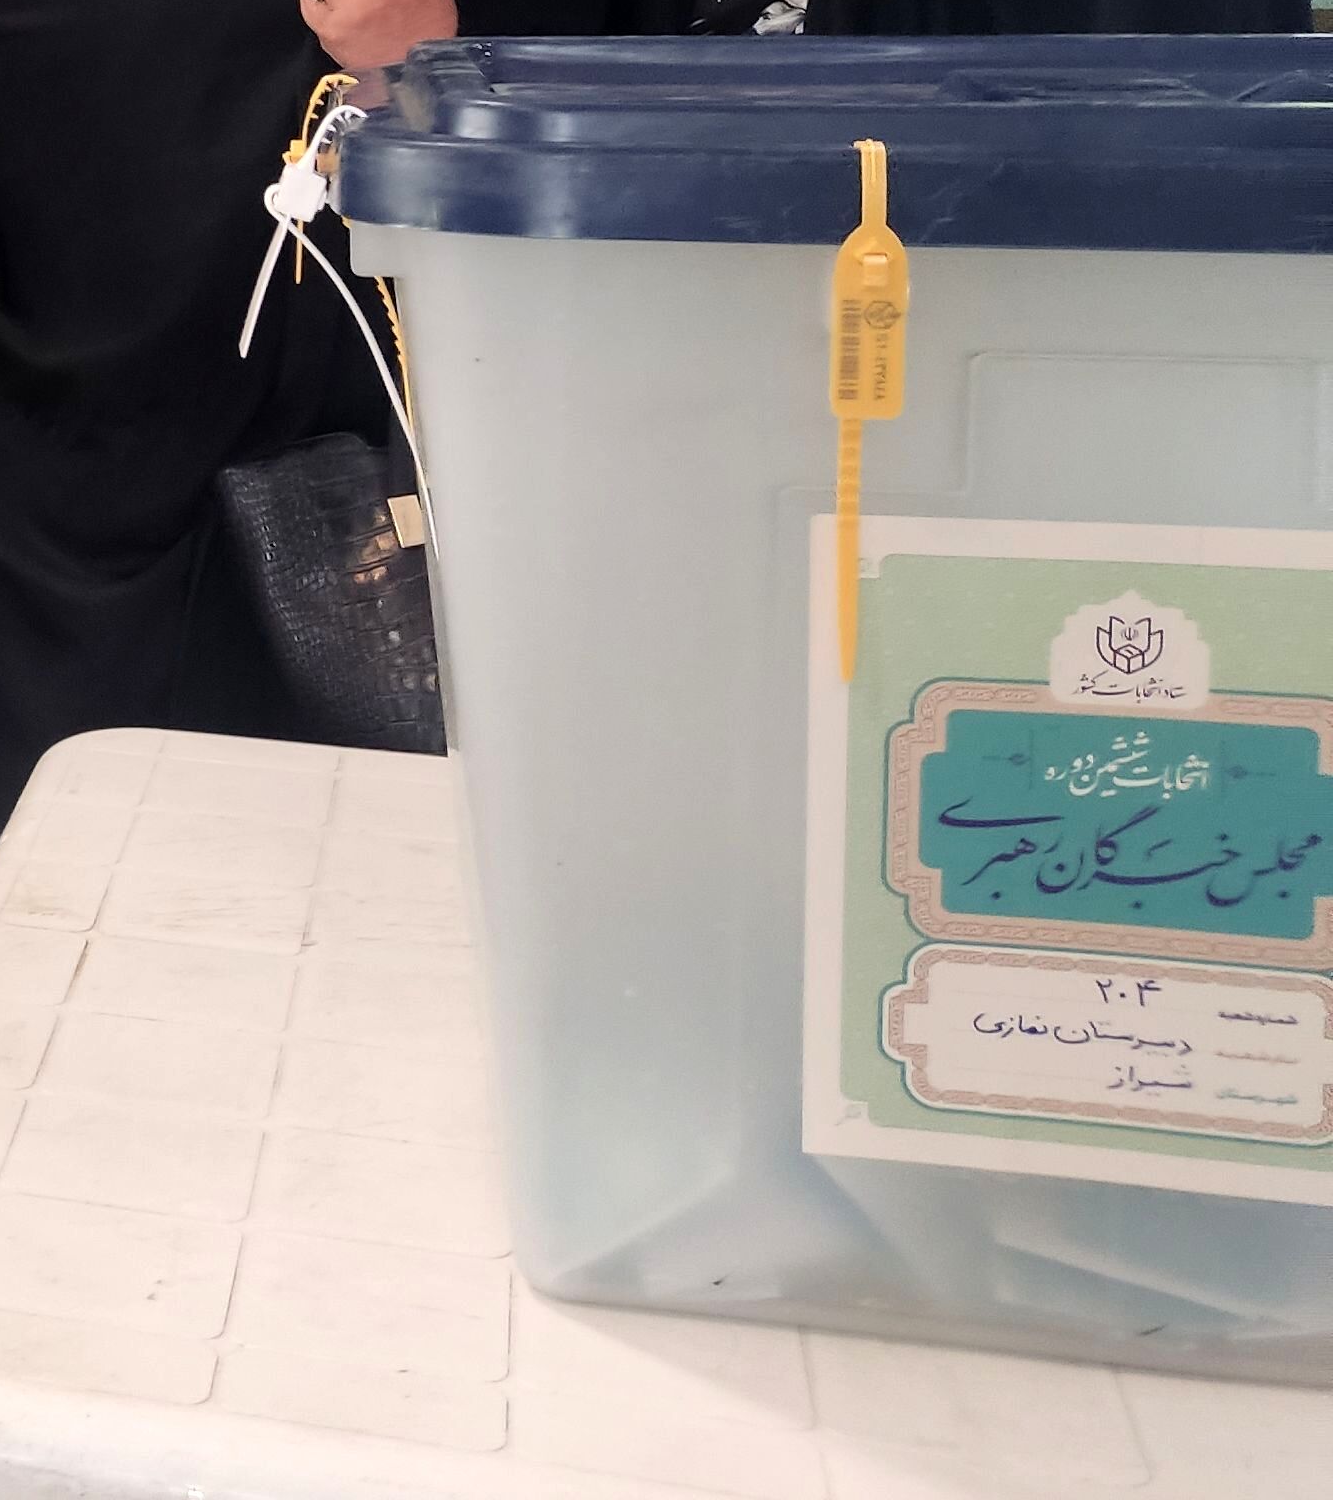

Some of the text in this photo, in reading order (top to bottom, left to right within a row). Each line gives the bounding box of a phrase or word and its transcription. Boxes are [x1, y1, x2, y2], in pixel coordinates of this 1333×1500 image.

[1071, 669, 1187, 703] ستاد انتخابات کشور
[1044, 731, 1210, 799] انتخابات ششمین دوره
[937, 798, 1323, 911] مجلس خبرگان رهبری
[1095, 978, 1162, 1006] ۲۰۴
[1107, 1063, 1193, 1097] شیراز
